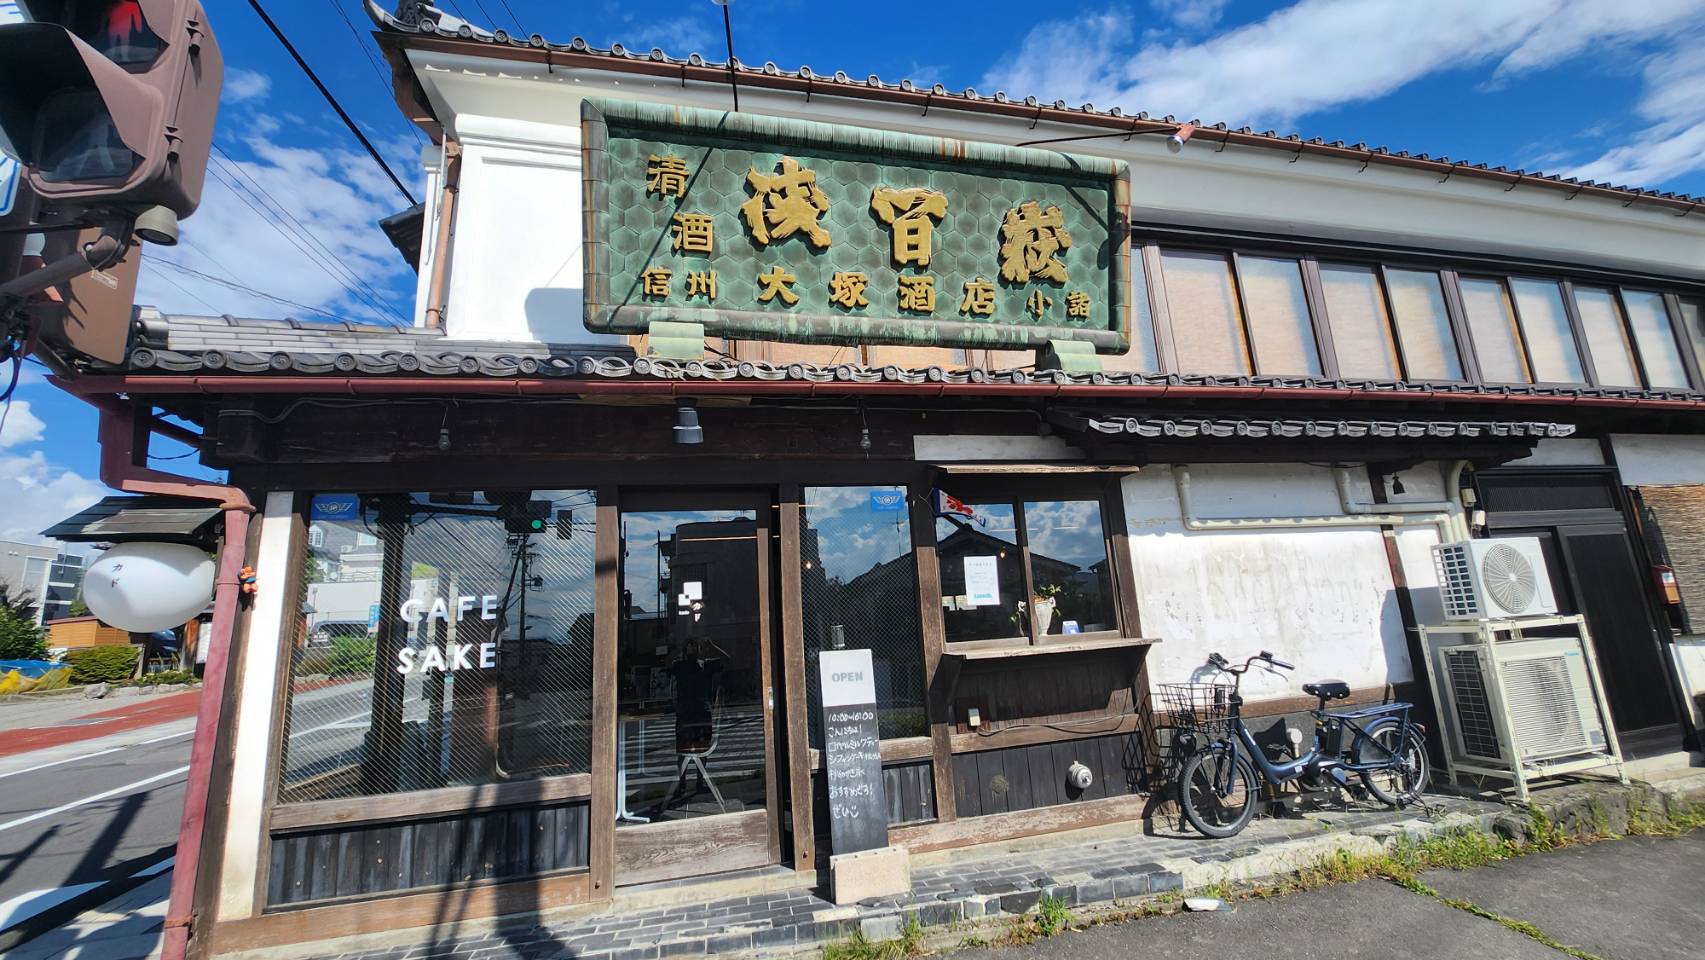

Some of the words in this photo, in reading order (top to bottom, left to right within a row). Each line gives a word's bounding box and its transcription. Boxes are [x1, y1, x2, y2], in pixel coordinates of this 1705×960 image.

[646, 154, 713, 251] 清酒
[642, 267, 717, 299] 信州
[399, 594, 498, 624] CAFE
[397, 642, 496, 675] SAKE
[831, 672, 863, 683] OPEN
